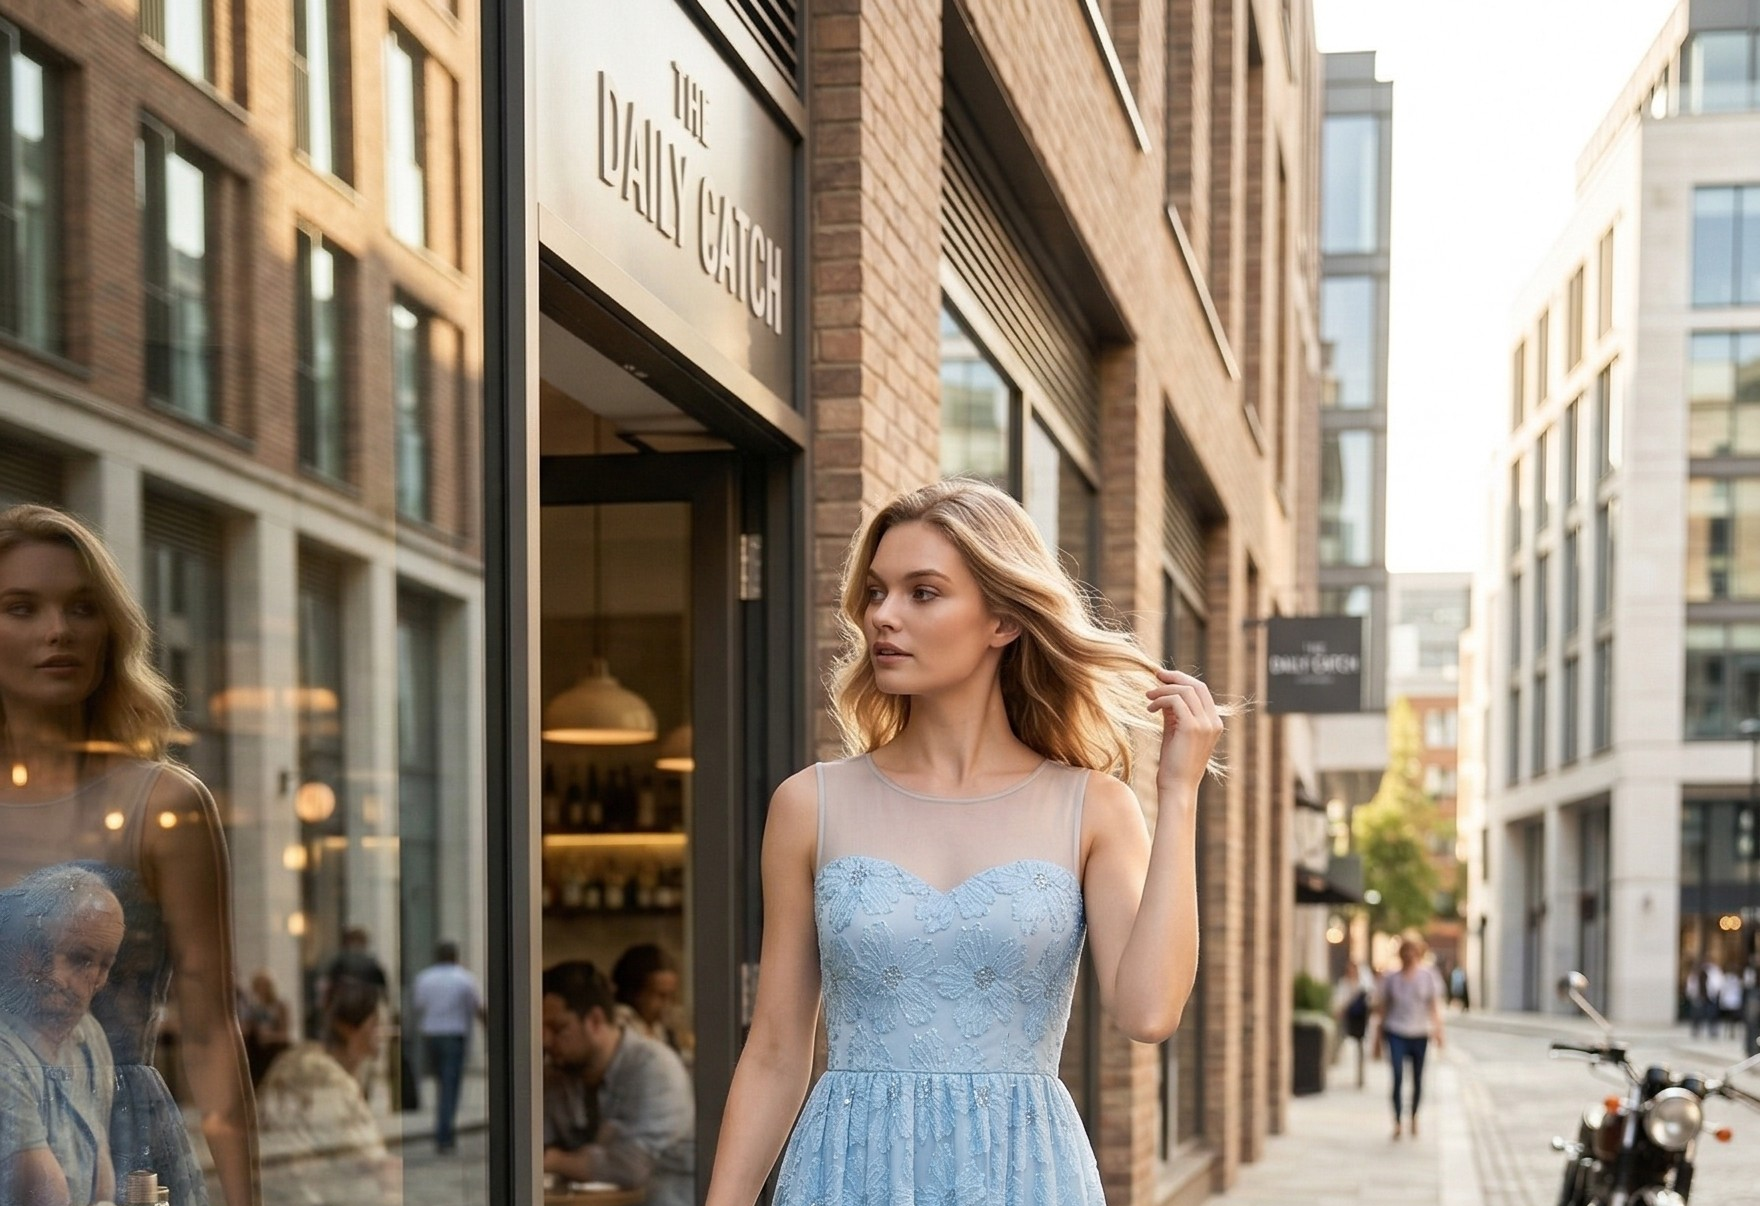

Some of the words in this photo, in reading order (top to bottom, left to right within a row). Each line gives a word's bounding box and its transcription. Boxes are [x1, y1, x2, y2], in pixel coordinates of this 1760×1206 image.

[670, 60, 710, 149] THE
[597, 70, 687, 249] DAILY
[698, 175, 783, 335] CATCH
